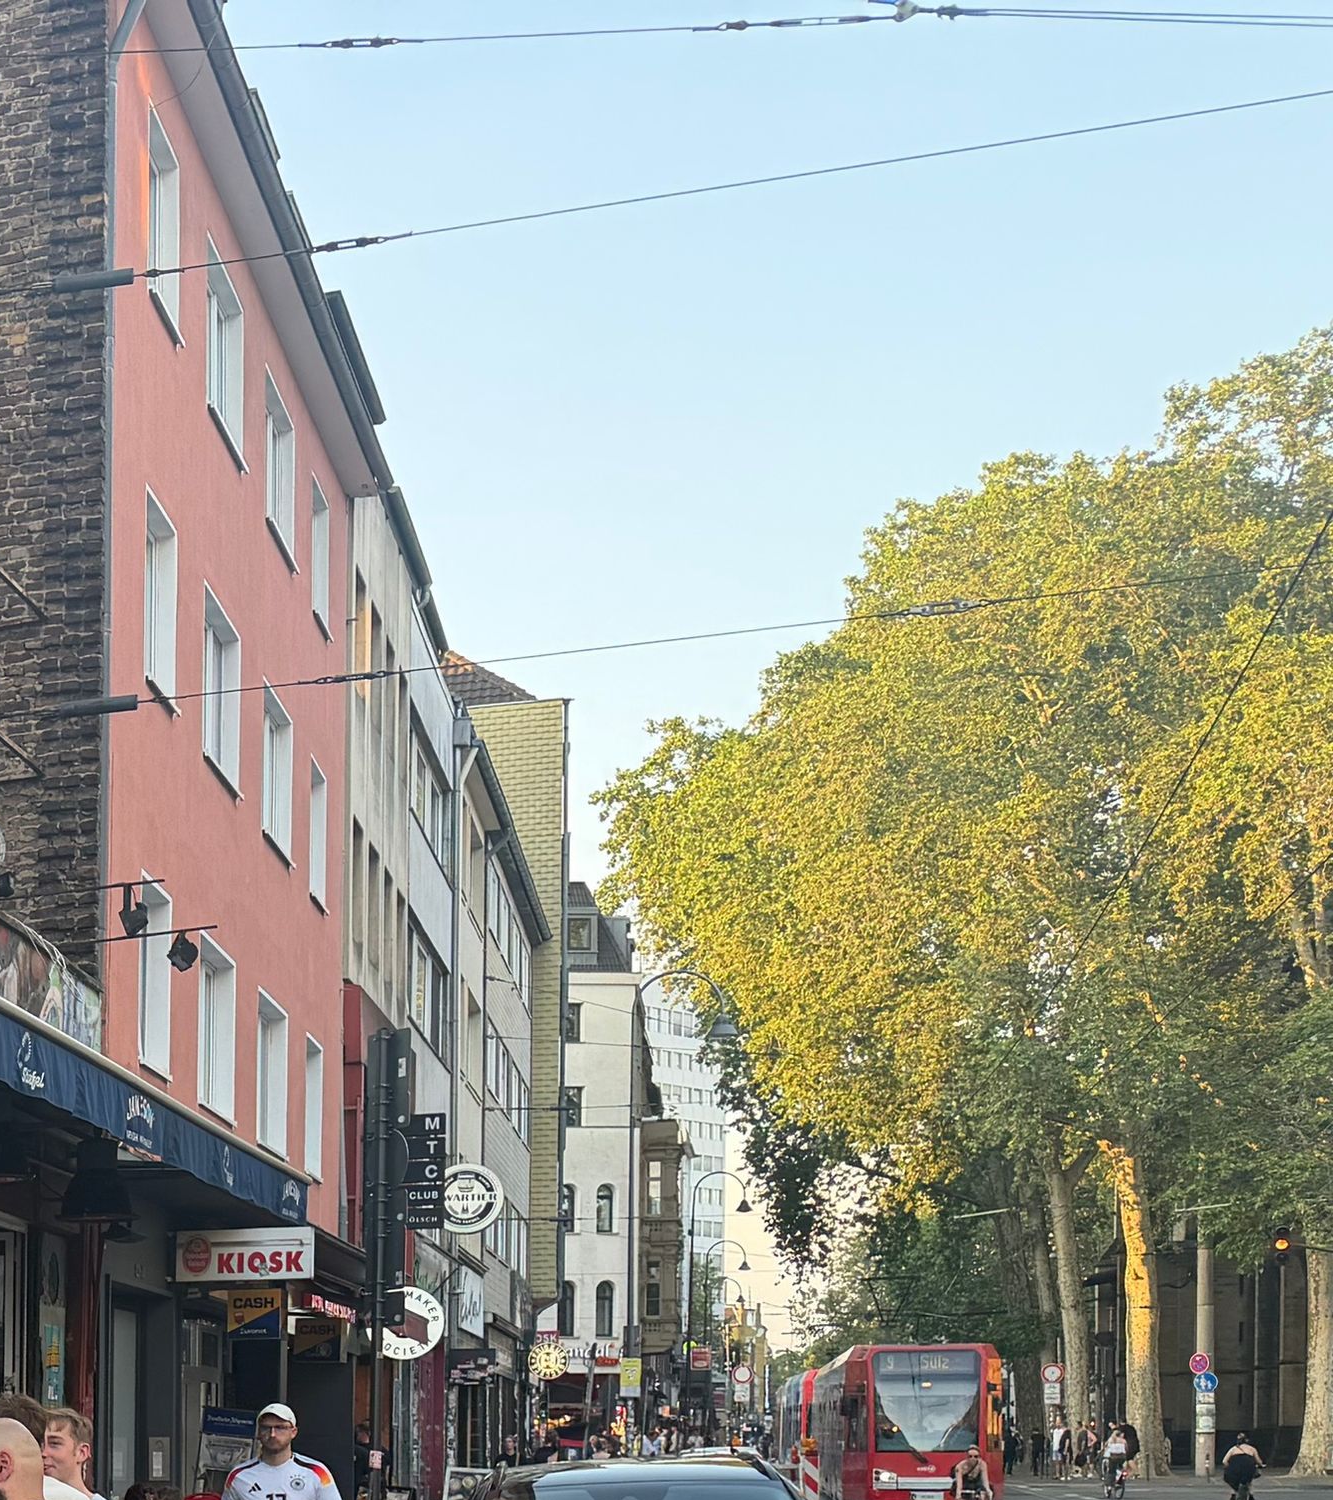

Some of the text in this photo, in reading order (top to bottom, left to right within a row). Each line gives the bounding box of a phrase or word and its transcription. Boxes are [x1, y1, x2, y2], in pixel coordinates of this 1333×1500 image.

[408, 1190, 439, 1201] CLUB
[217, 1250, 305, 1275] KIOSK
[233, 1296, 275, 1310] CASH
[405, 1290, 440, 1323] MAKER
[382, 1338, 432, 1357] OCIETY
